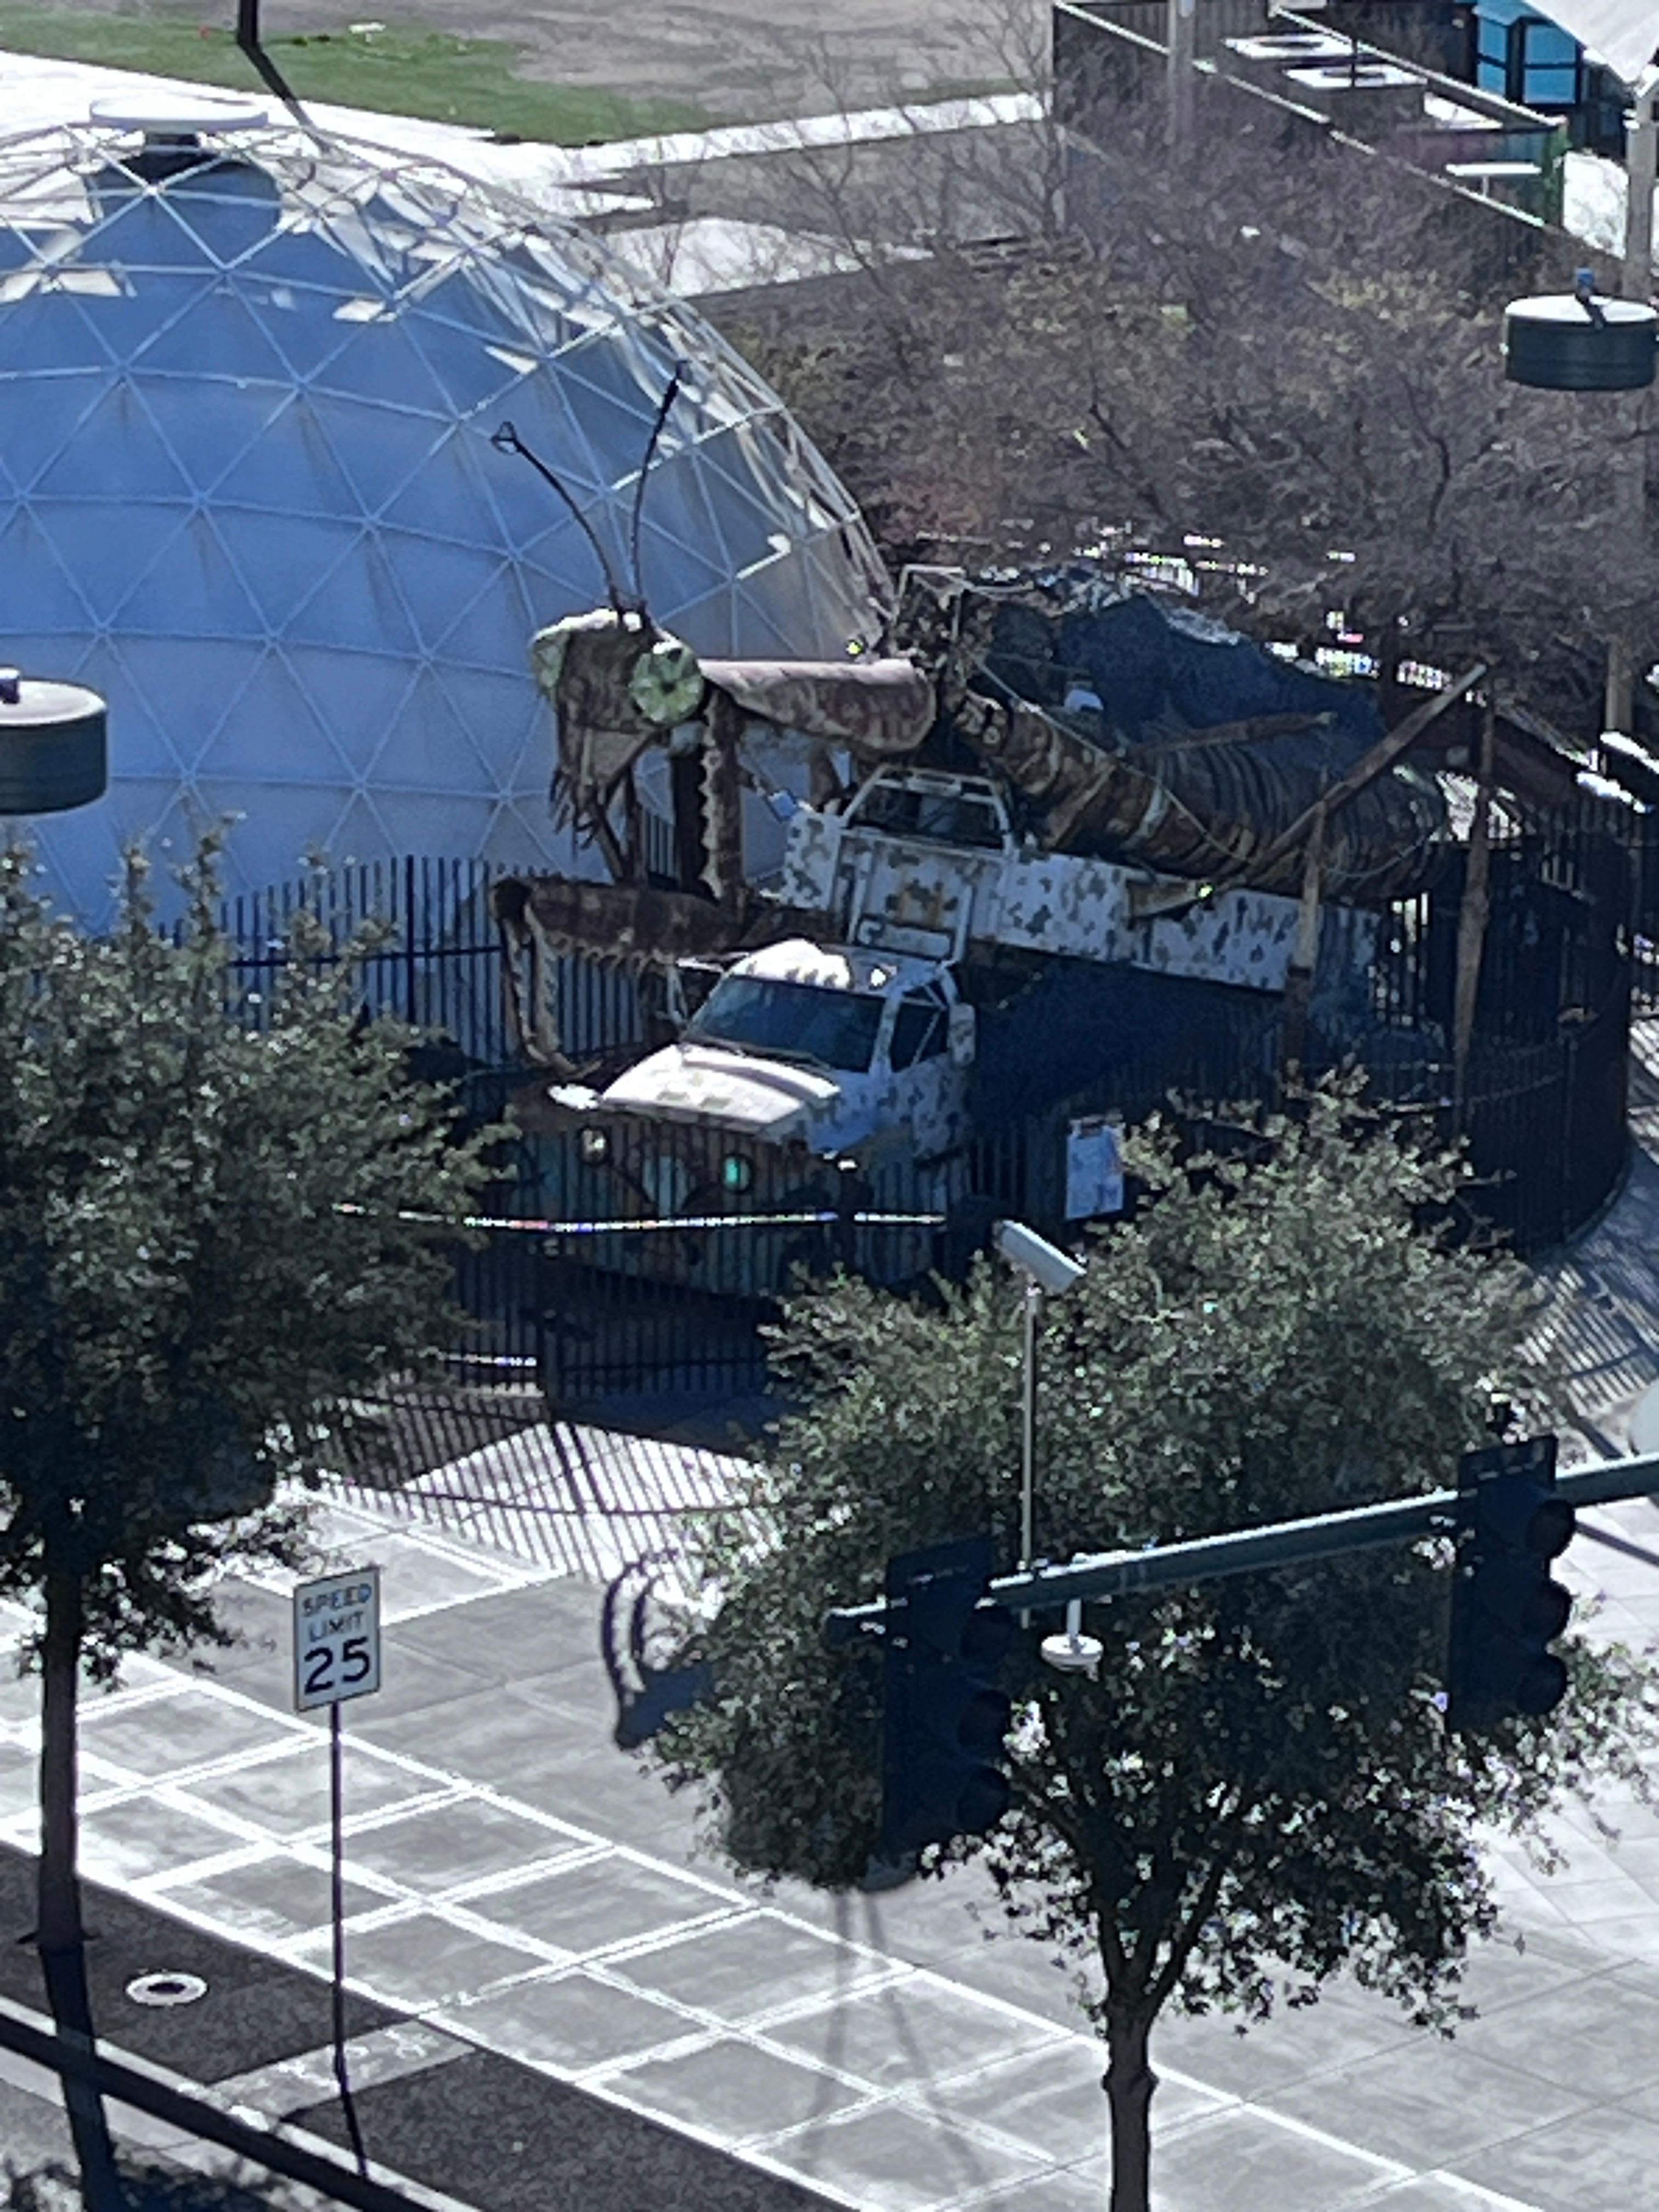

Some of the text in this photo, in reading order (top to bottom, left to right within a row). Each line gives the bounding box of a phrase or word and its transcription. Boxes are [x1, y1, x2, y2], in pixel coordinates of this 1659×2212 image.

[303, 1583, 372, 1617] SPEED
[309, 1611, 363, 1642] LIMIT
[304, 1637, 370, 1695] 25
